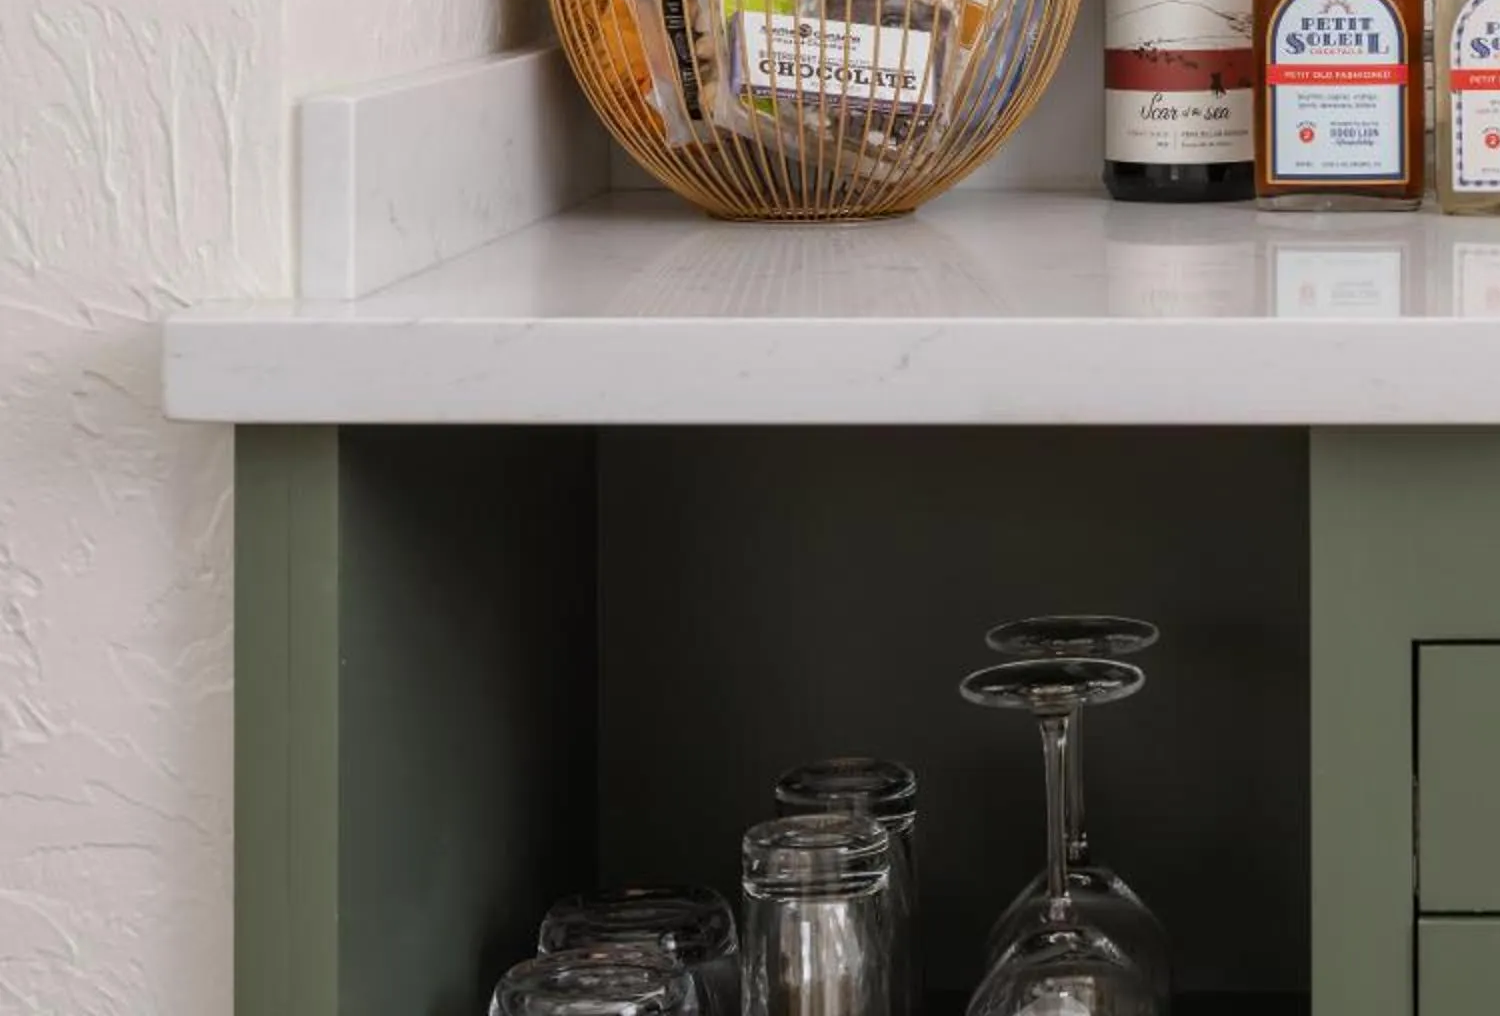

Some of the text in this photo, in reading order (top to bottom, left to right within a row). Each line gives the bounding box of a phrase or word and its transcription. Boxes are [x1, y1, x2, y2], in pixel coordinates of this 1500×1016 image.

[1301, 17, 1374, 31] PETIT
[1286, 32, 1390, 55] SOLEIL
[758, 59, 917, 91] CHOCOLATE
[1284, 70, 1310, 79] PETIT
[1469, 75, 1496, 85] PETIT
[1140, 92, 1179, 121] Scar
[1203, 105, 1232, 121] sea
